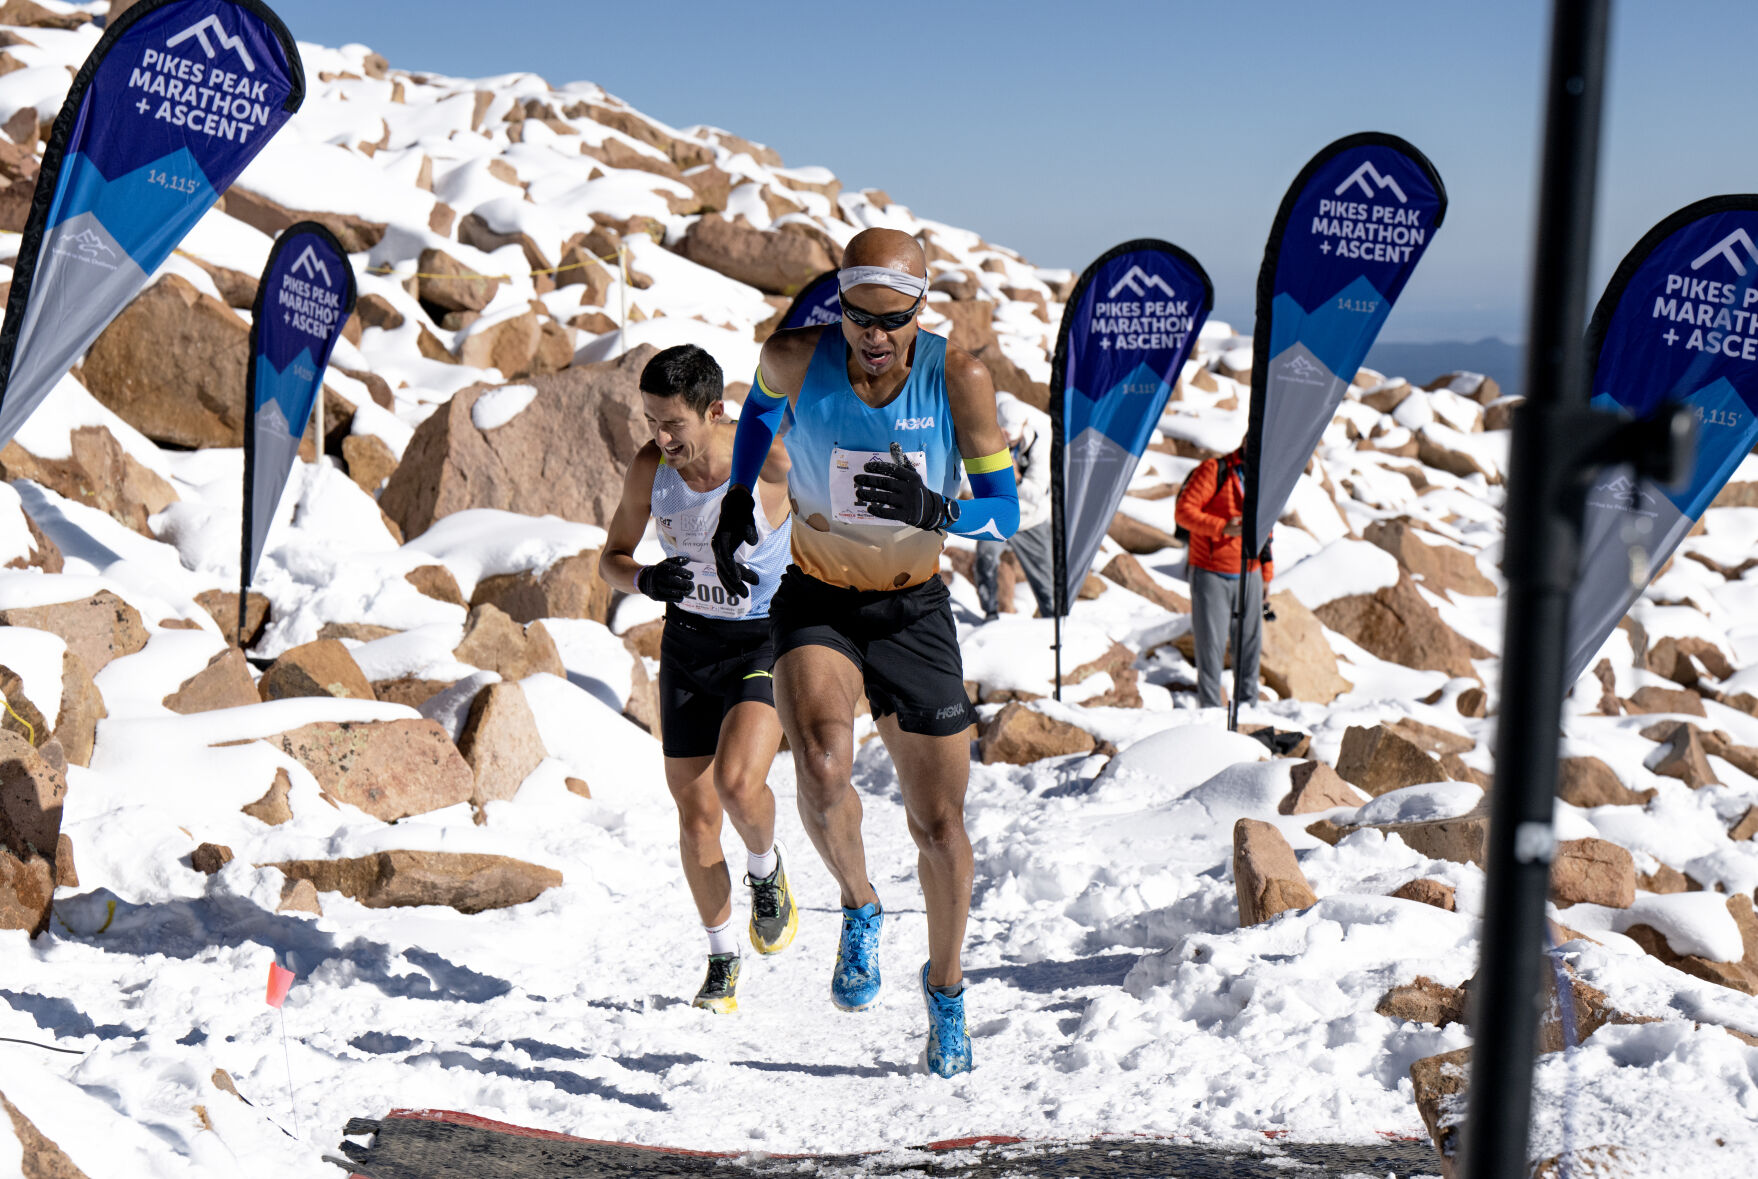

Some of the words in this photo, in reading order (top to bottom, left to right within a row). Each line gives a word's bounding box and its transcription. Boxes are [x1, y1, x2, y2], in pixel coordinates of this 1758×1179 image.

[142, 48, 205, 83] PIKES
[208, 68, 269, 102] PEAK
[128, 67, 270, 126] MARATHON
[154, 100, 254, 144] ASCENT
[1319, 199, 1368, 221] PIKES
[1372, 205, 1421, 227] PEAK
[1311, 216, 1425, 246] MARATHON
[1336, 240, 1415, 264] ASCENT
[282, 274, 310, 297] PIKES
[312, 286, 339, 308] PEAK
[1665, 274, 1737, 304] PIKES
[1095, 301, 1141, 318] PIKES
[1144, 300, 1189, 316] PEAK
[1091, 316, 1193, 334] MARATHON
[1115, 333, 1185, 350] ASCENT
[894, 416, 935, 431] HOKA
[1687, 404, 1742, 428] 4,115'
[684, 583, 740, 607] 008
[935, 702, 965, 720] HOKA
